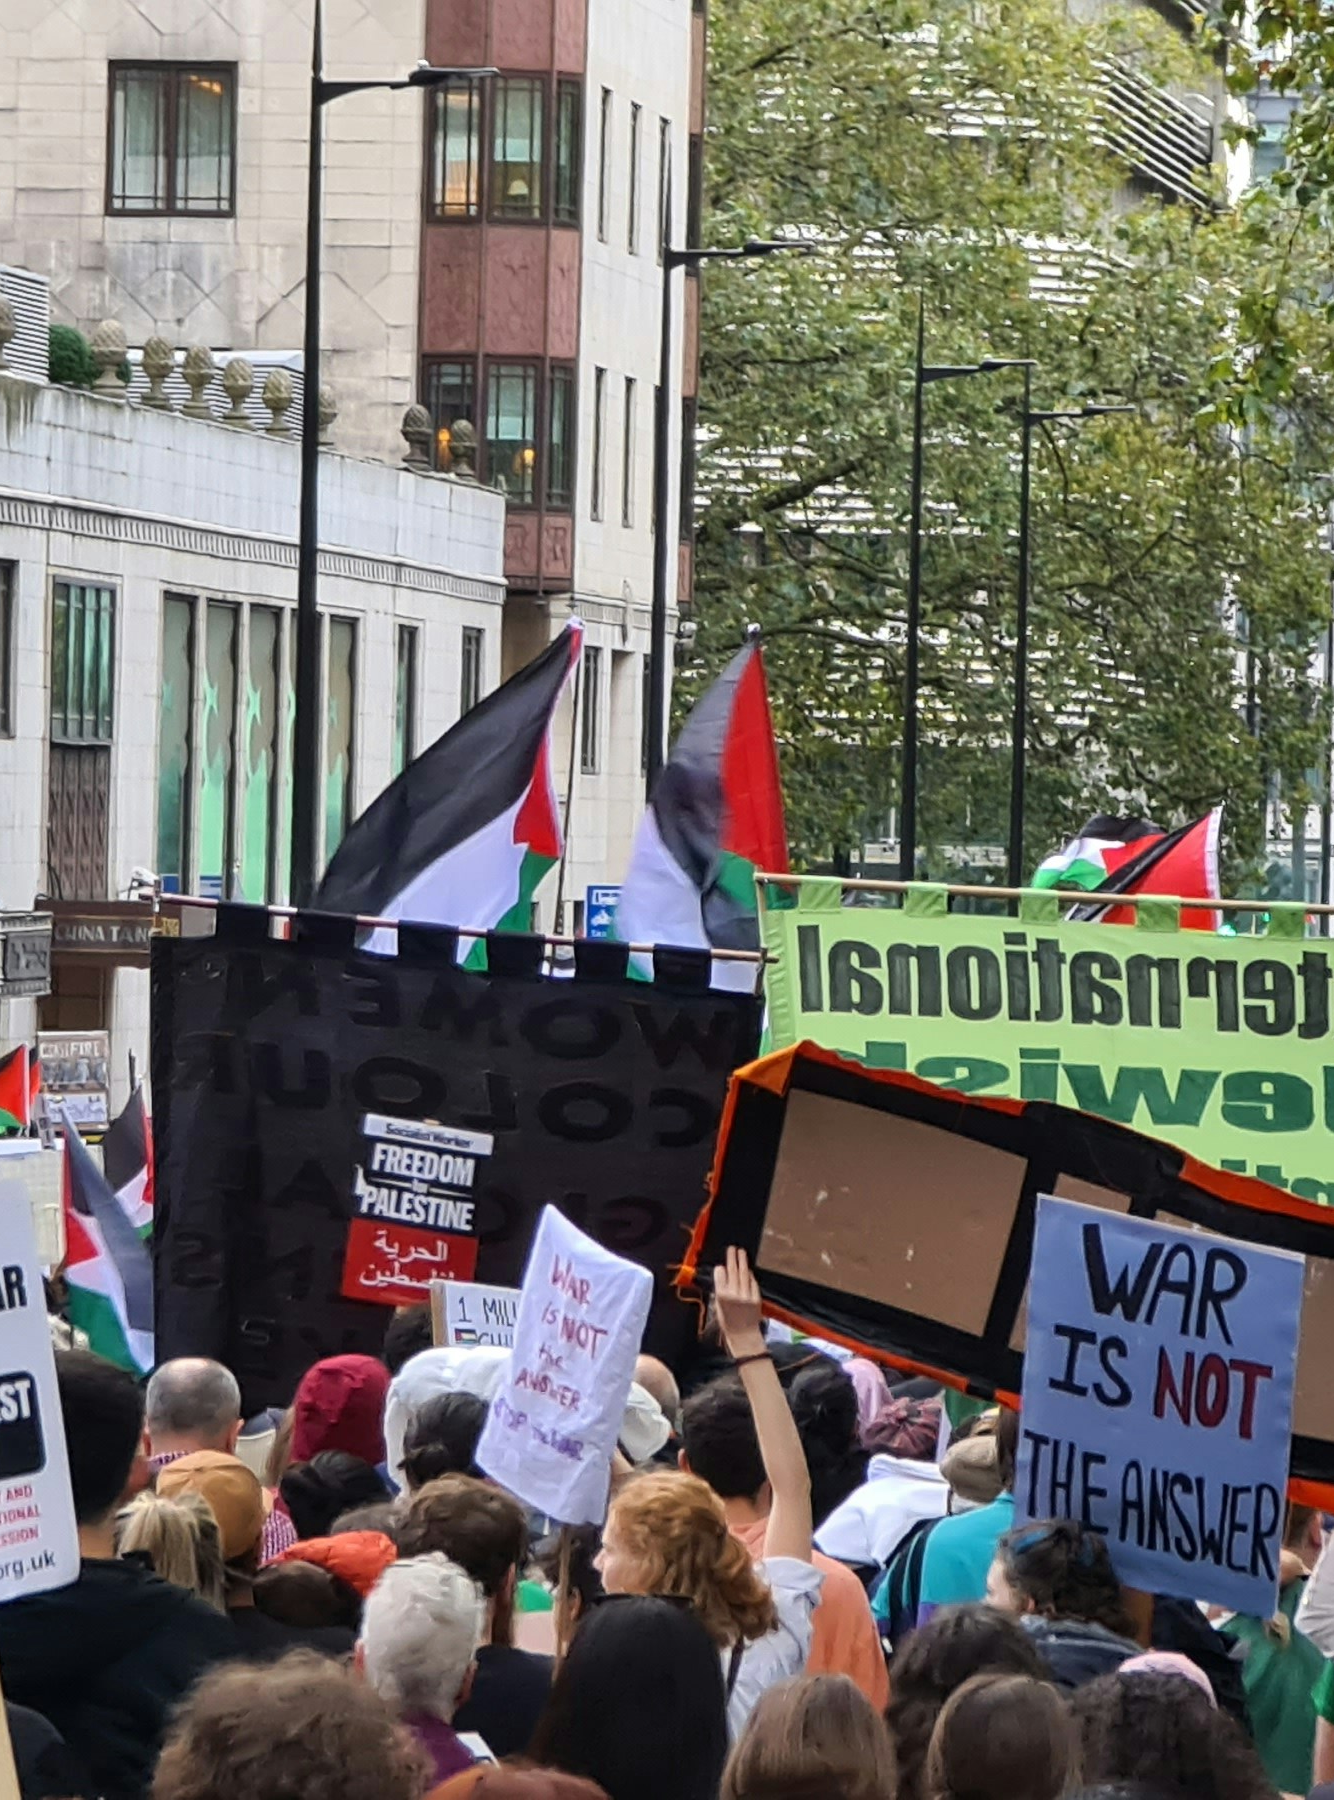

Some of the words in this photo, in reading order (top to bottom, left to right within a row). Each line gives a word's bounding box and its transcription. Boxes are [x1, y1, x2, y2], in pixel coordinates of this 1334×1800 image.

[371, 1142, 475, 1187] FREEDOM
[360, 1184, 475, 1231] PALESTINE
[373, 1230, 449, 1263] الحرية
[551, 1254, 591, 1305] WAR
[1082, 1222, 1248, 1347] WAR
[561, 1317, 609, 1360] NOT
[514, 1367, 581, 1412] ANSWER
[1048, 1323, 1133, 1408] IS
[1153, 1345, 1274, 1441] NOT
[5, 1484, 33, 1500] AND
[1023, 1429, 1109, 1535] THE
[1119, 1459, 1283, 1582] ANSWER
